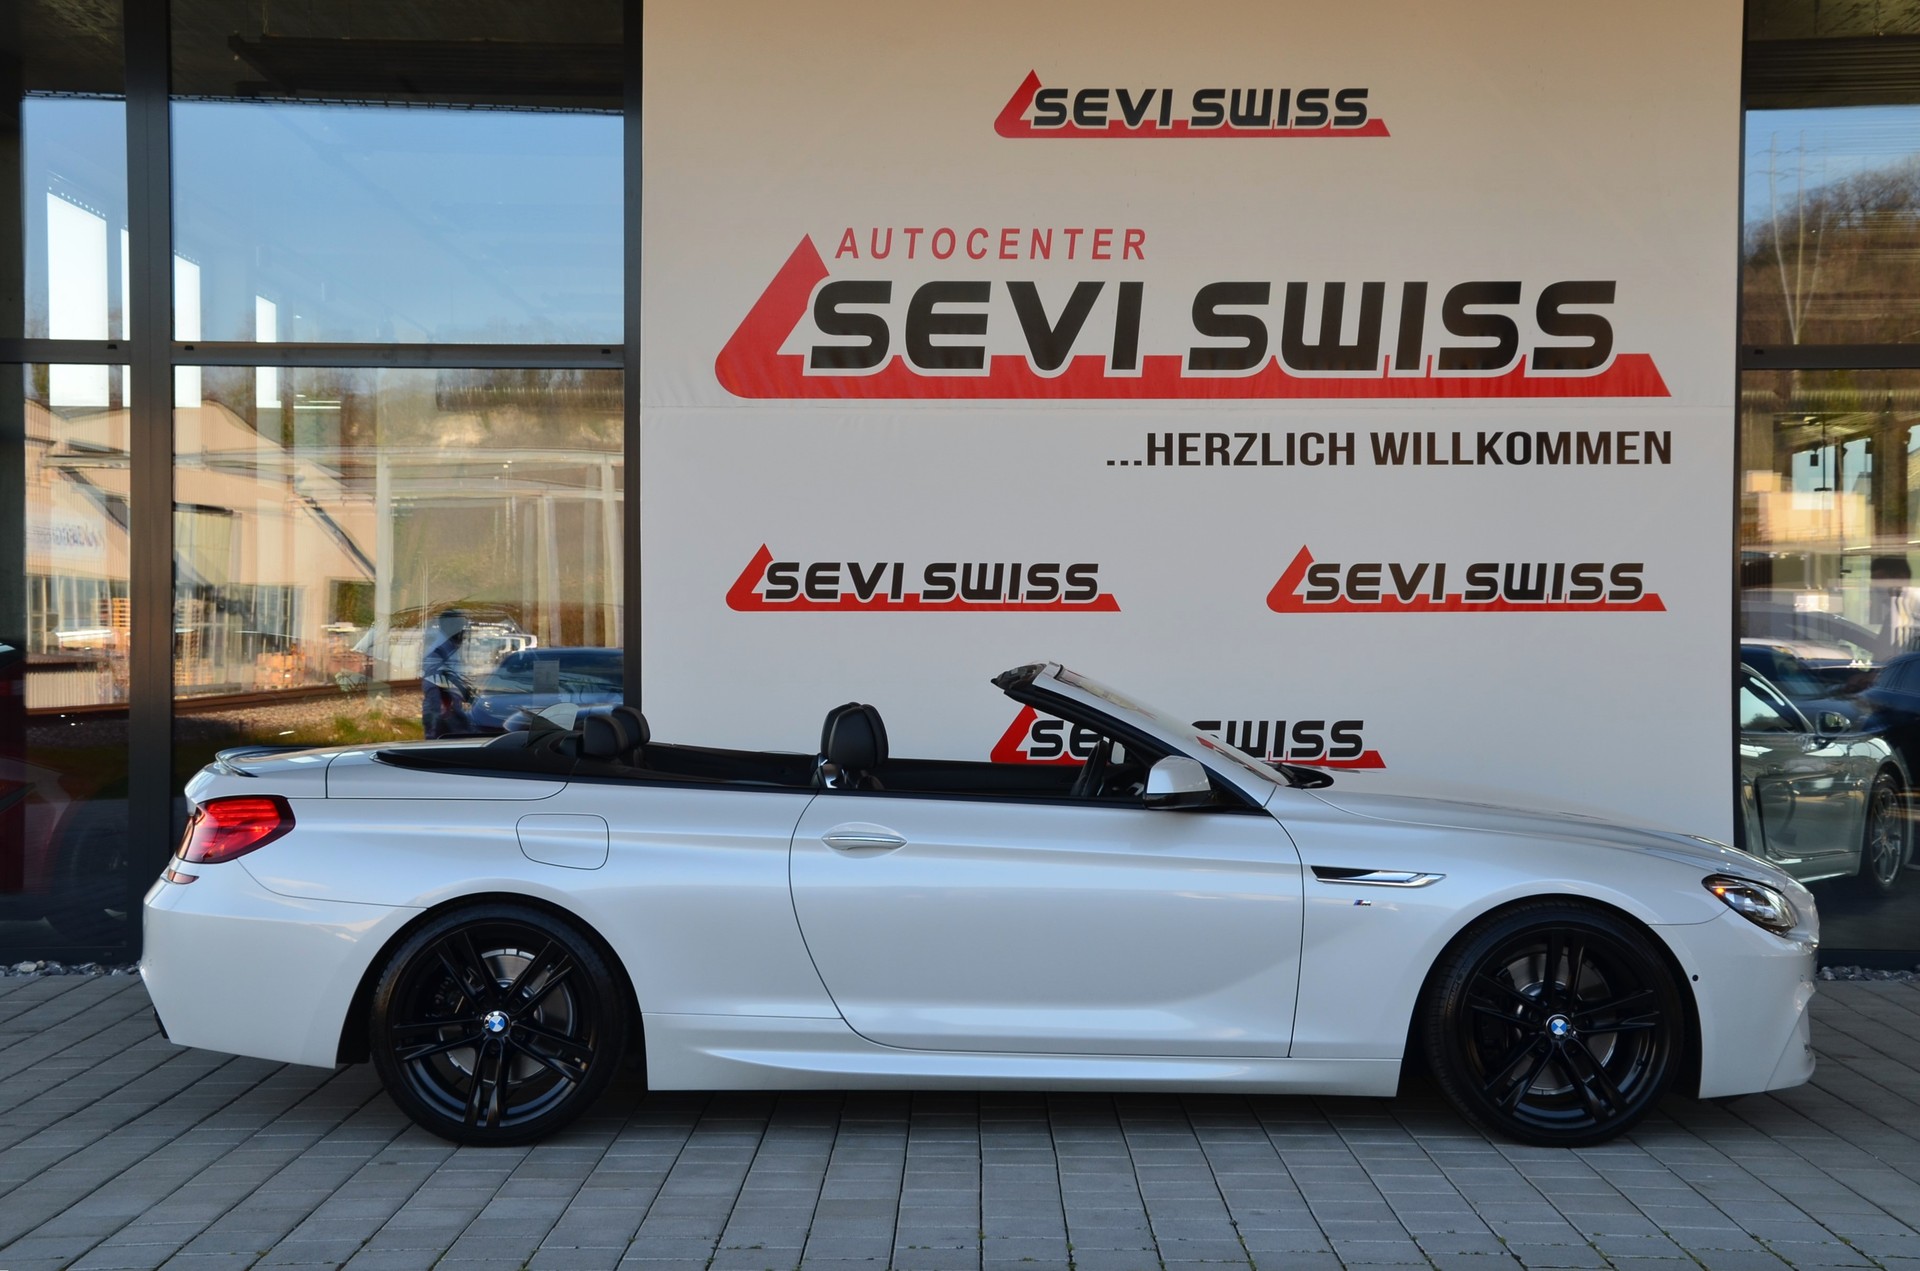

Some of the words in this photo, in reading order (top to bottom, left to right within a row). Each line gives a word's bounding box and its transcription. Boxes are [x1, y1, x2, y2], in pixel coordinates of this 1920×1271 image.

[1033, 88, 1174, 127] SEVI
[1190, 88, 1369, 127] SWISS
[835, 227, 1147, 261] AUTOCENTER
[810, 280, 1144, 371] SEVI
[1187, 280, 1617, 371] SWISS
[1369, 430, 1672, 466] WILLKOMMEN
[765, 561, 905, 600] SEVI
[922, 562, 1099, 601] SWISS
[1306, 562, 1447, 601] SEVI
[1464, 562, 1644, 601] SWISS
